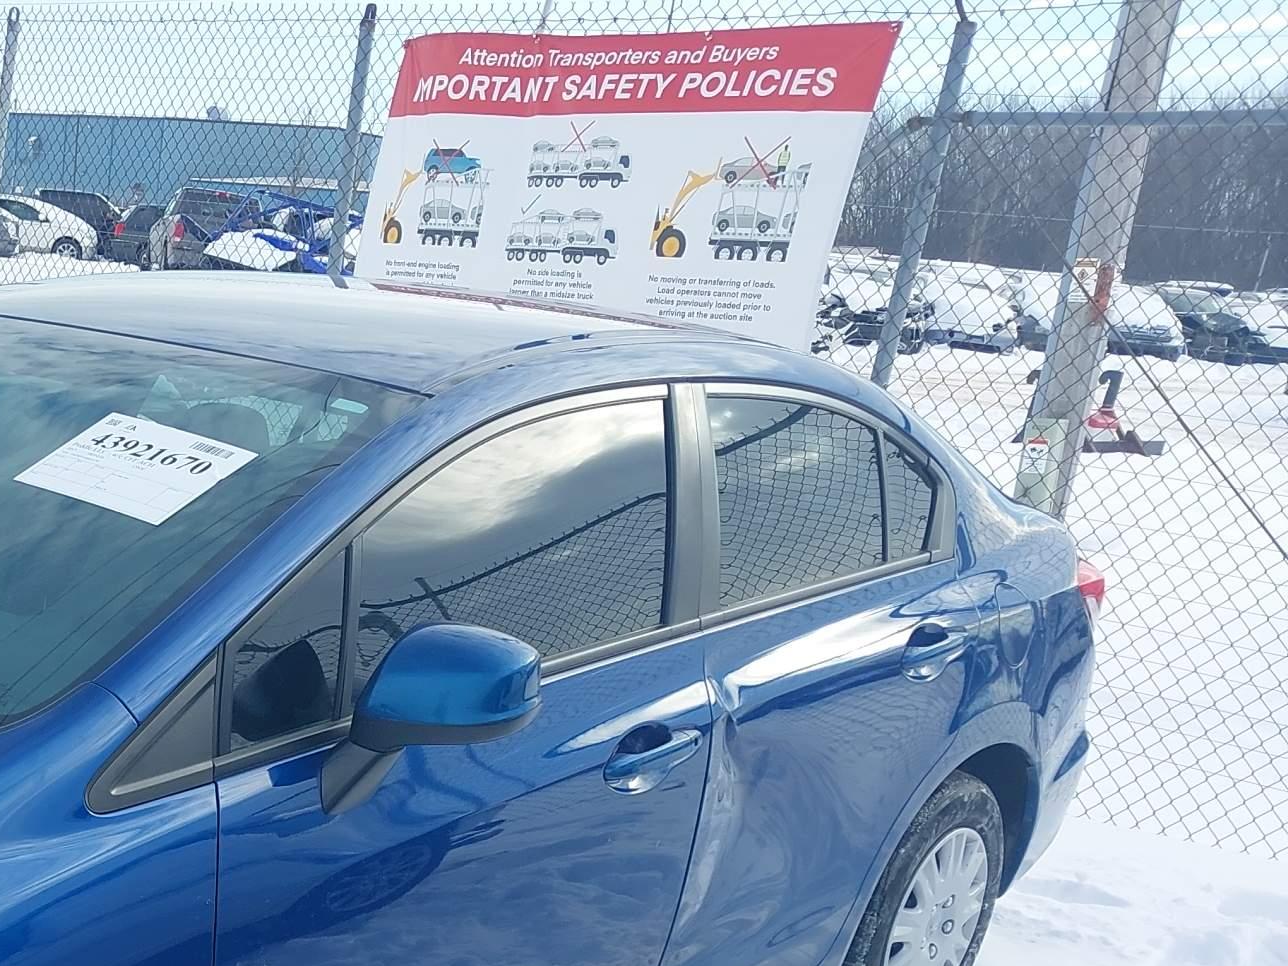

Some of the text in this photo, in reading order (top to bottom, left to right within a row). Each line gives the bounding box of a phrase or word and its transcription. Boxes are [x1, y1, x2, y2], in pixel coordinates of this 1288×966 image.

[458, 44, 780, 70] Attention Transporters and Buyers
[412, 67, 838, 103] MPORTANT SAFETY POLICIES
[418, 261, 436, 270] engine
[438, 261, 460, 272] loading
[391, 270, 416, 278] permitted
[425, 272, 435, 280] any
[437, 272, 457, 281] vehicle
[527, 268, 537, 276] No
[551, 269, 575, 279] loading
[577, 270, 582, 278] is
[513, 279, 592, 289] permitted for any vehicle
[660, 275, 687, 285] moving
[698, 278, 741, 288] transferring
[752, 280, 776, 289] loads.
[531, 289, 543, 297] than
[549, 290, 576, 299] midsize
[577, 292, 595, 300] truck
[676, 288, 711, 297] operators
[712, 290, 739, 298] cannot
[645, 297, 772, 312] vehicles previously loaded prior to
[658, 309, 686, 319] arriving
[696, 311, 708, 319] the
[709, 312, 738, 321] auction
[739, 314, 753, 322] site
[91, 433, 213, 475] 43921670
